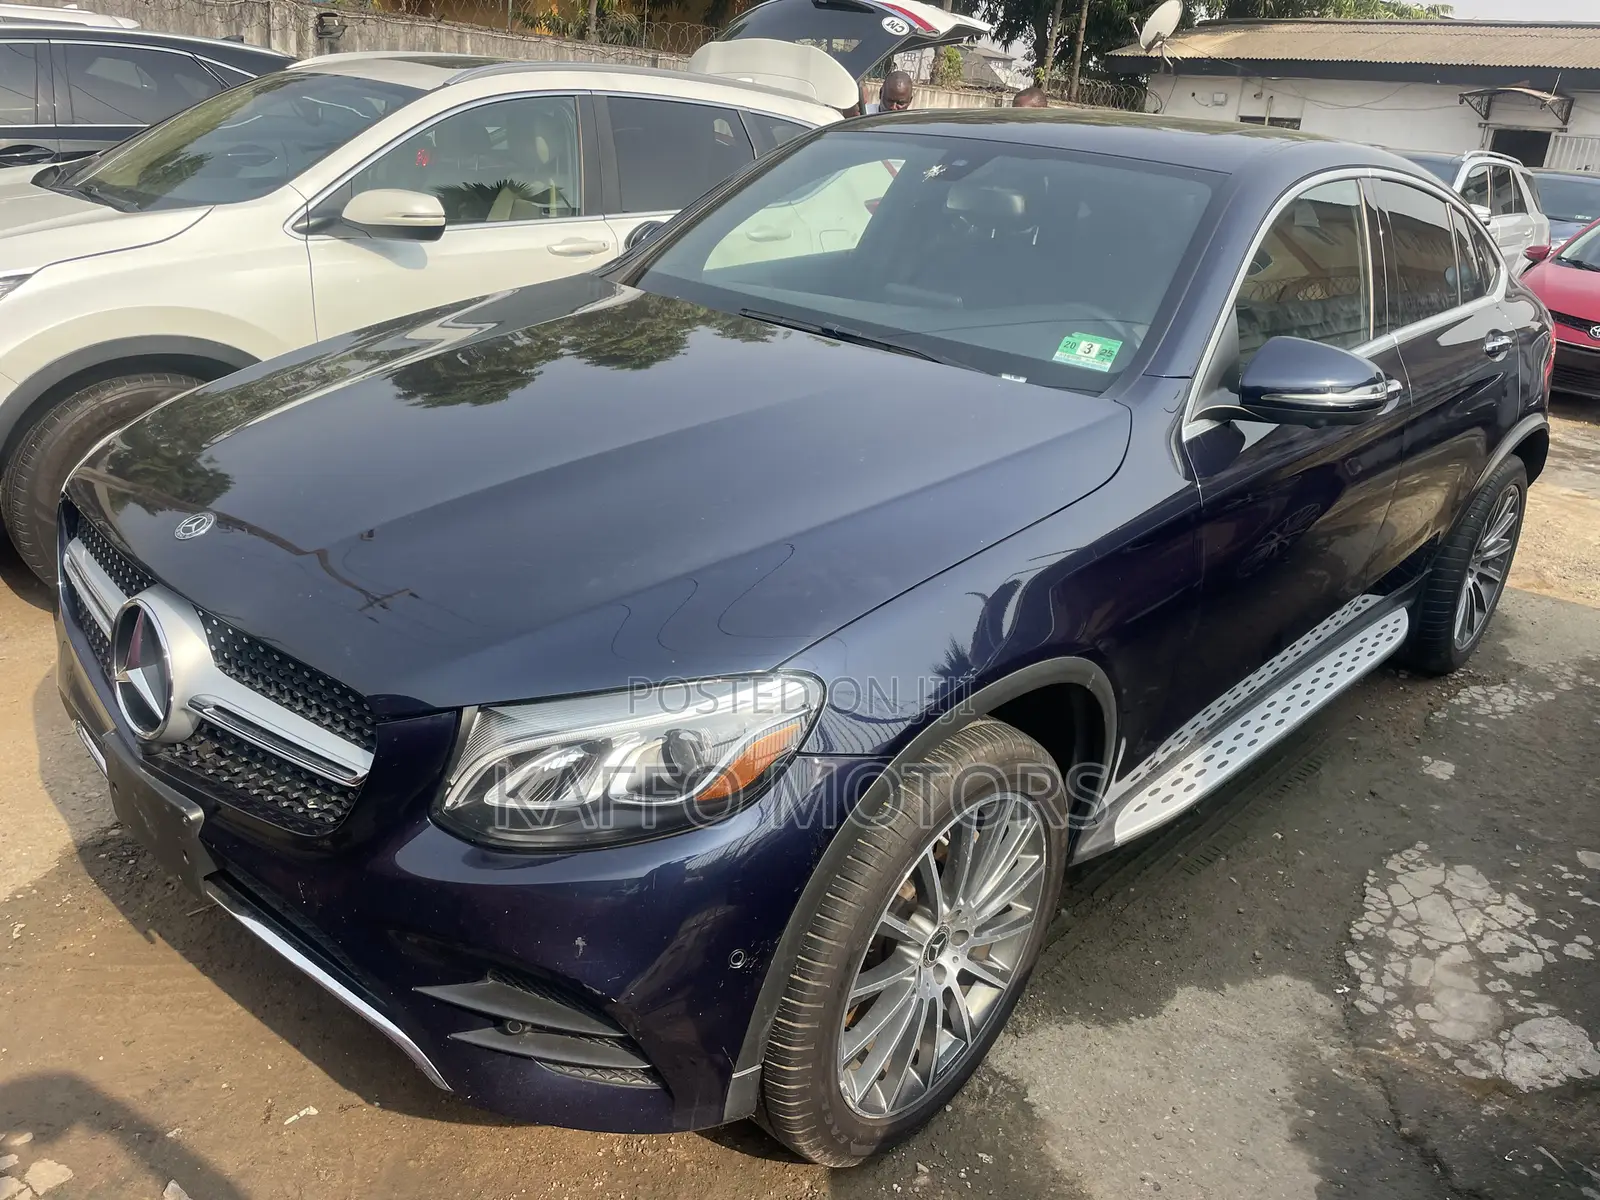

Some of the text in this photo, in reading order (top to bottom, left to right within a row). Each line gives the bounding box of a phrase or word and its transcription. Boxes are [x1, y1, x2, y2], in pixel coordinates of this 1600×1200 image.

[886, 20, 905, 33] CM
[1063, 341, 1115, 358] 20 3 25
